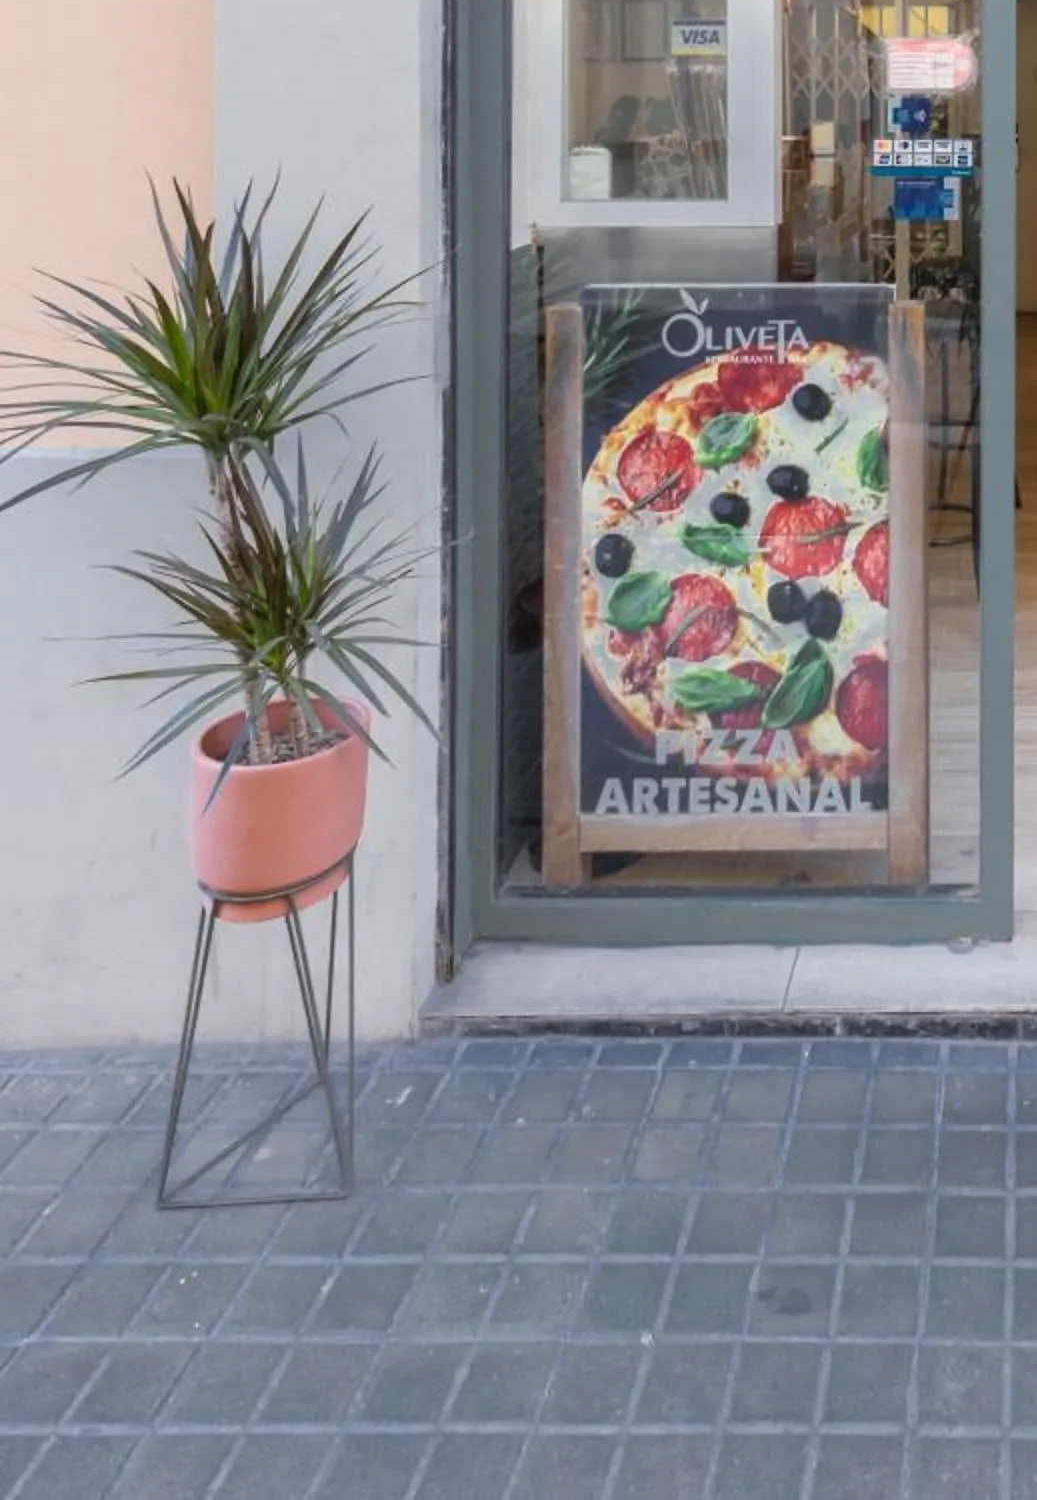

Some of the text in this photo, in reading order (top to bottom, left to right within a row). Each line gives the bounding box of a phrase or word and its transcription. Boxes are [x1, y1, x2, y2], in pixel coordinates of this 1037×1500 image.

[681, 29, 720, 45] VISA
[662, 312, 809, 364] OLIVETA
[655, 729, 801, 764] PIZZA
[595, 776, 871, 814] ARTESANAL
